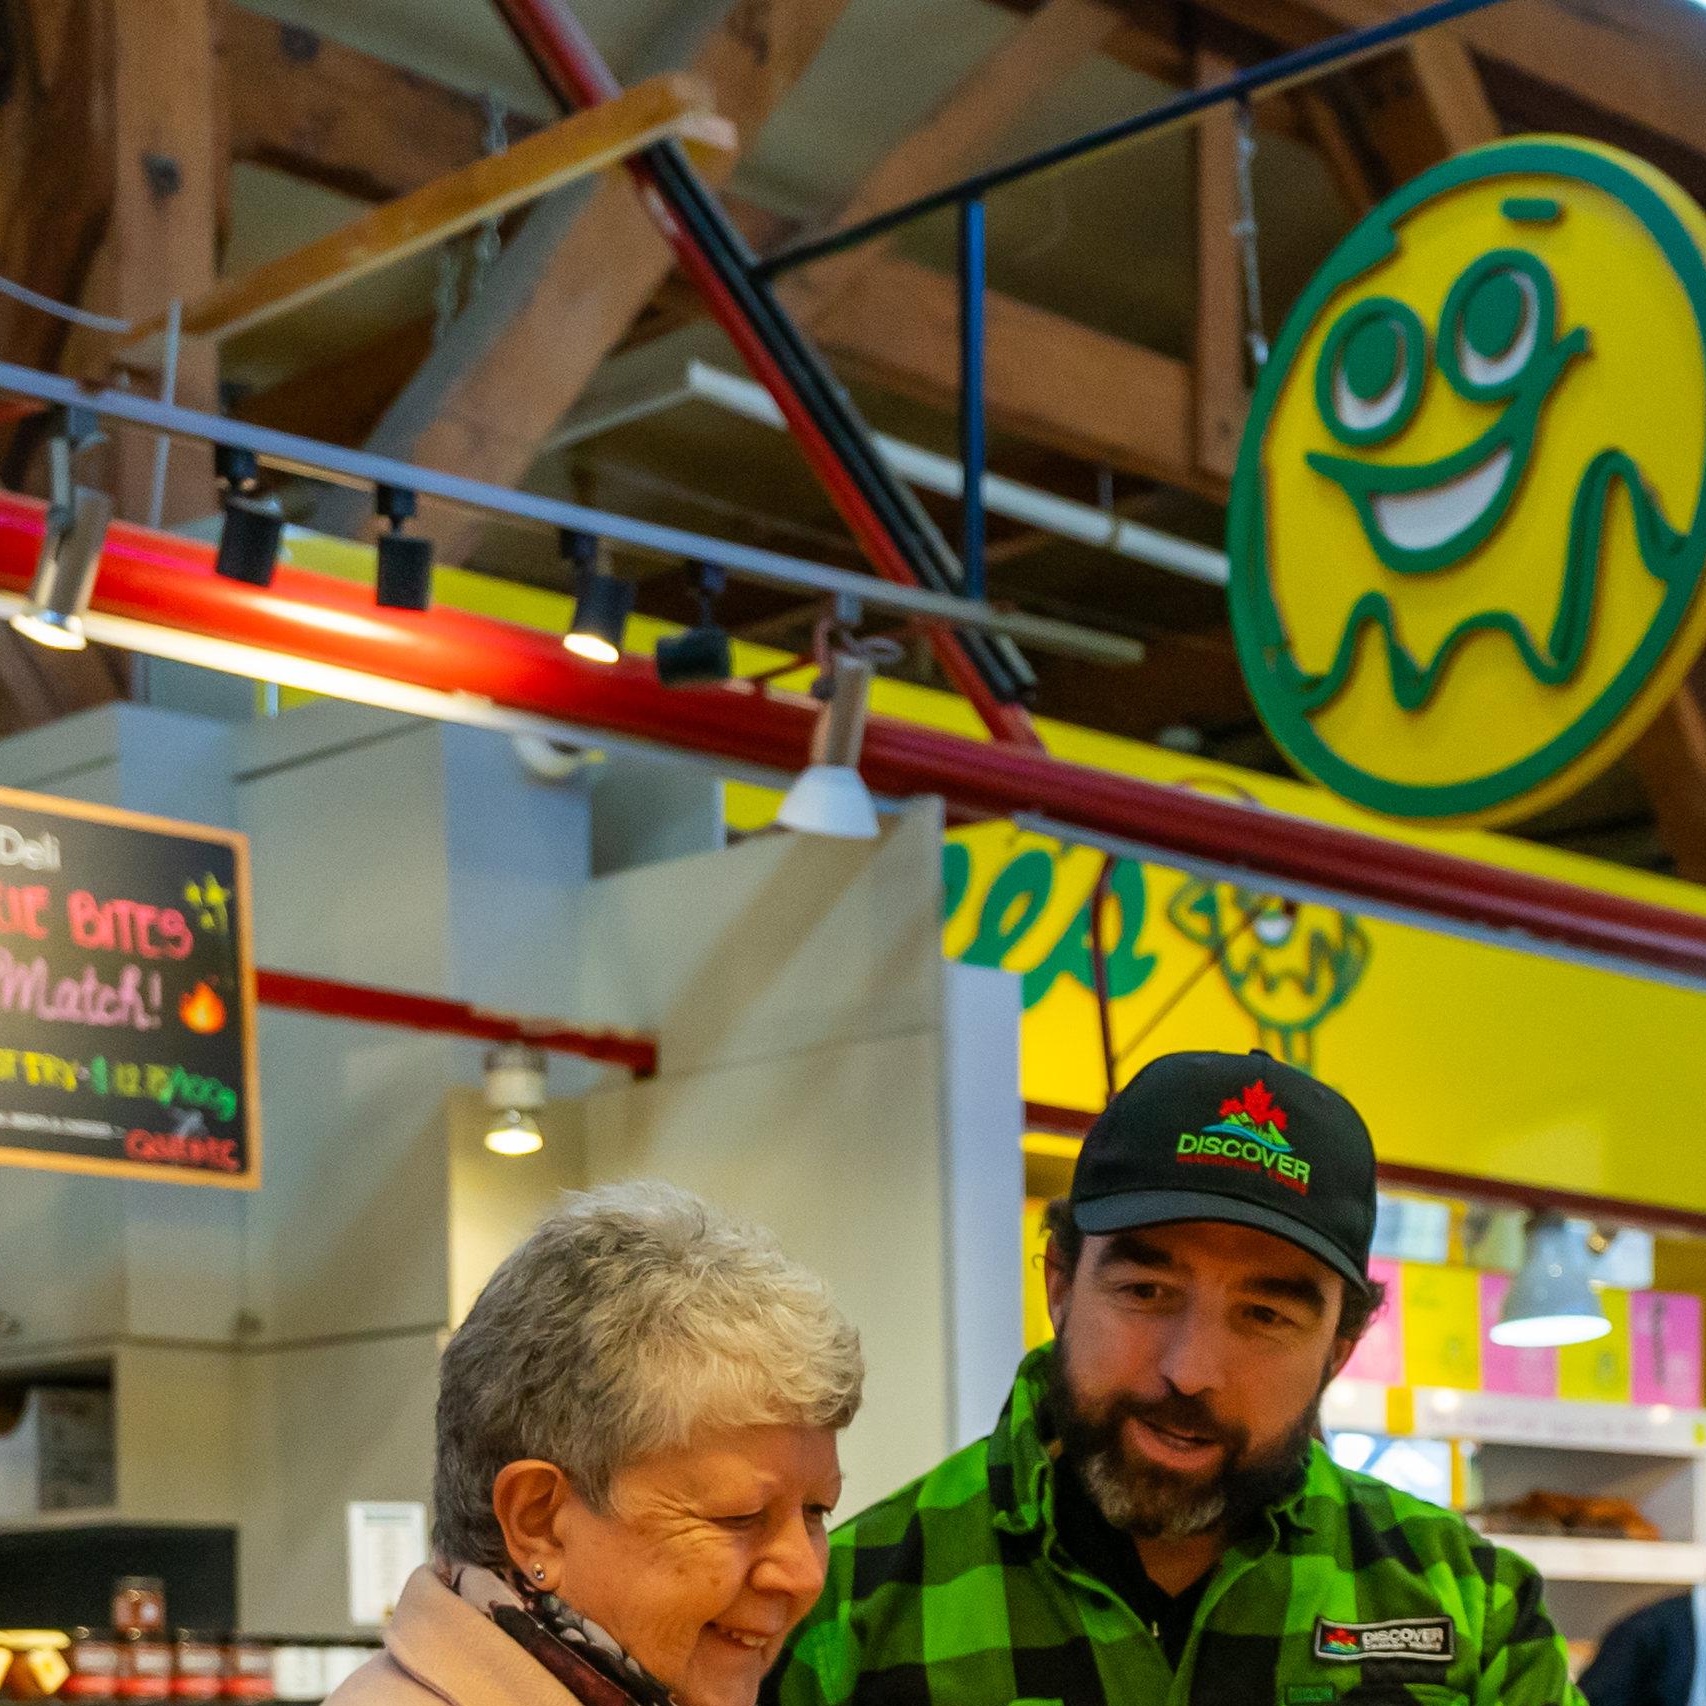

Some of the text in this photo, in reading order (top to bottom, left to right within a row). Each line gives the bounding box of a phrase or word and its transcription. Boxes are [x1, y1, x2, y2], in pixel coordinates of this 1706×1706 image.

[67, 889, 194, 960] BITES
[1176, 1132, 1311, 1185] DISCOVER
[1361, 1626, 1445, 1647] DISCOVER
